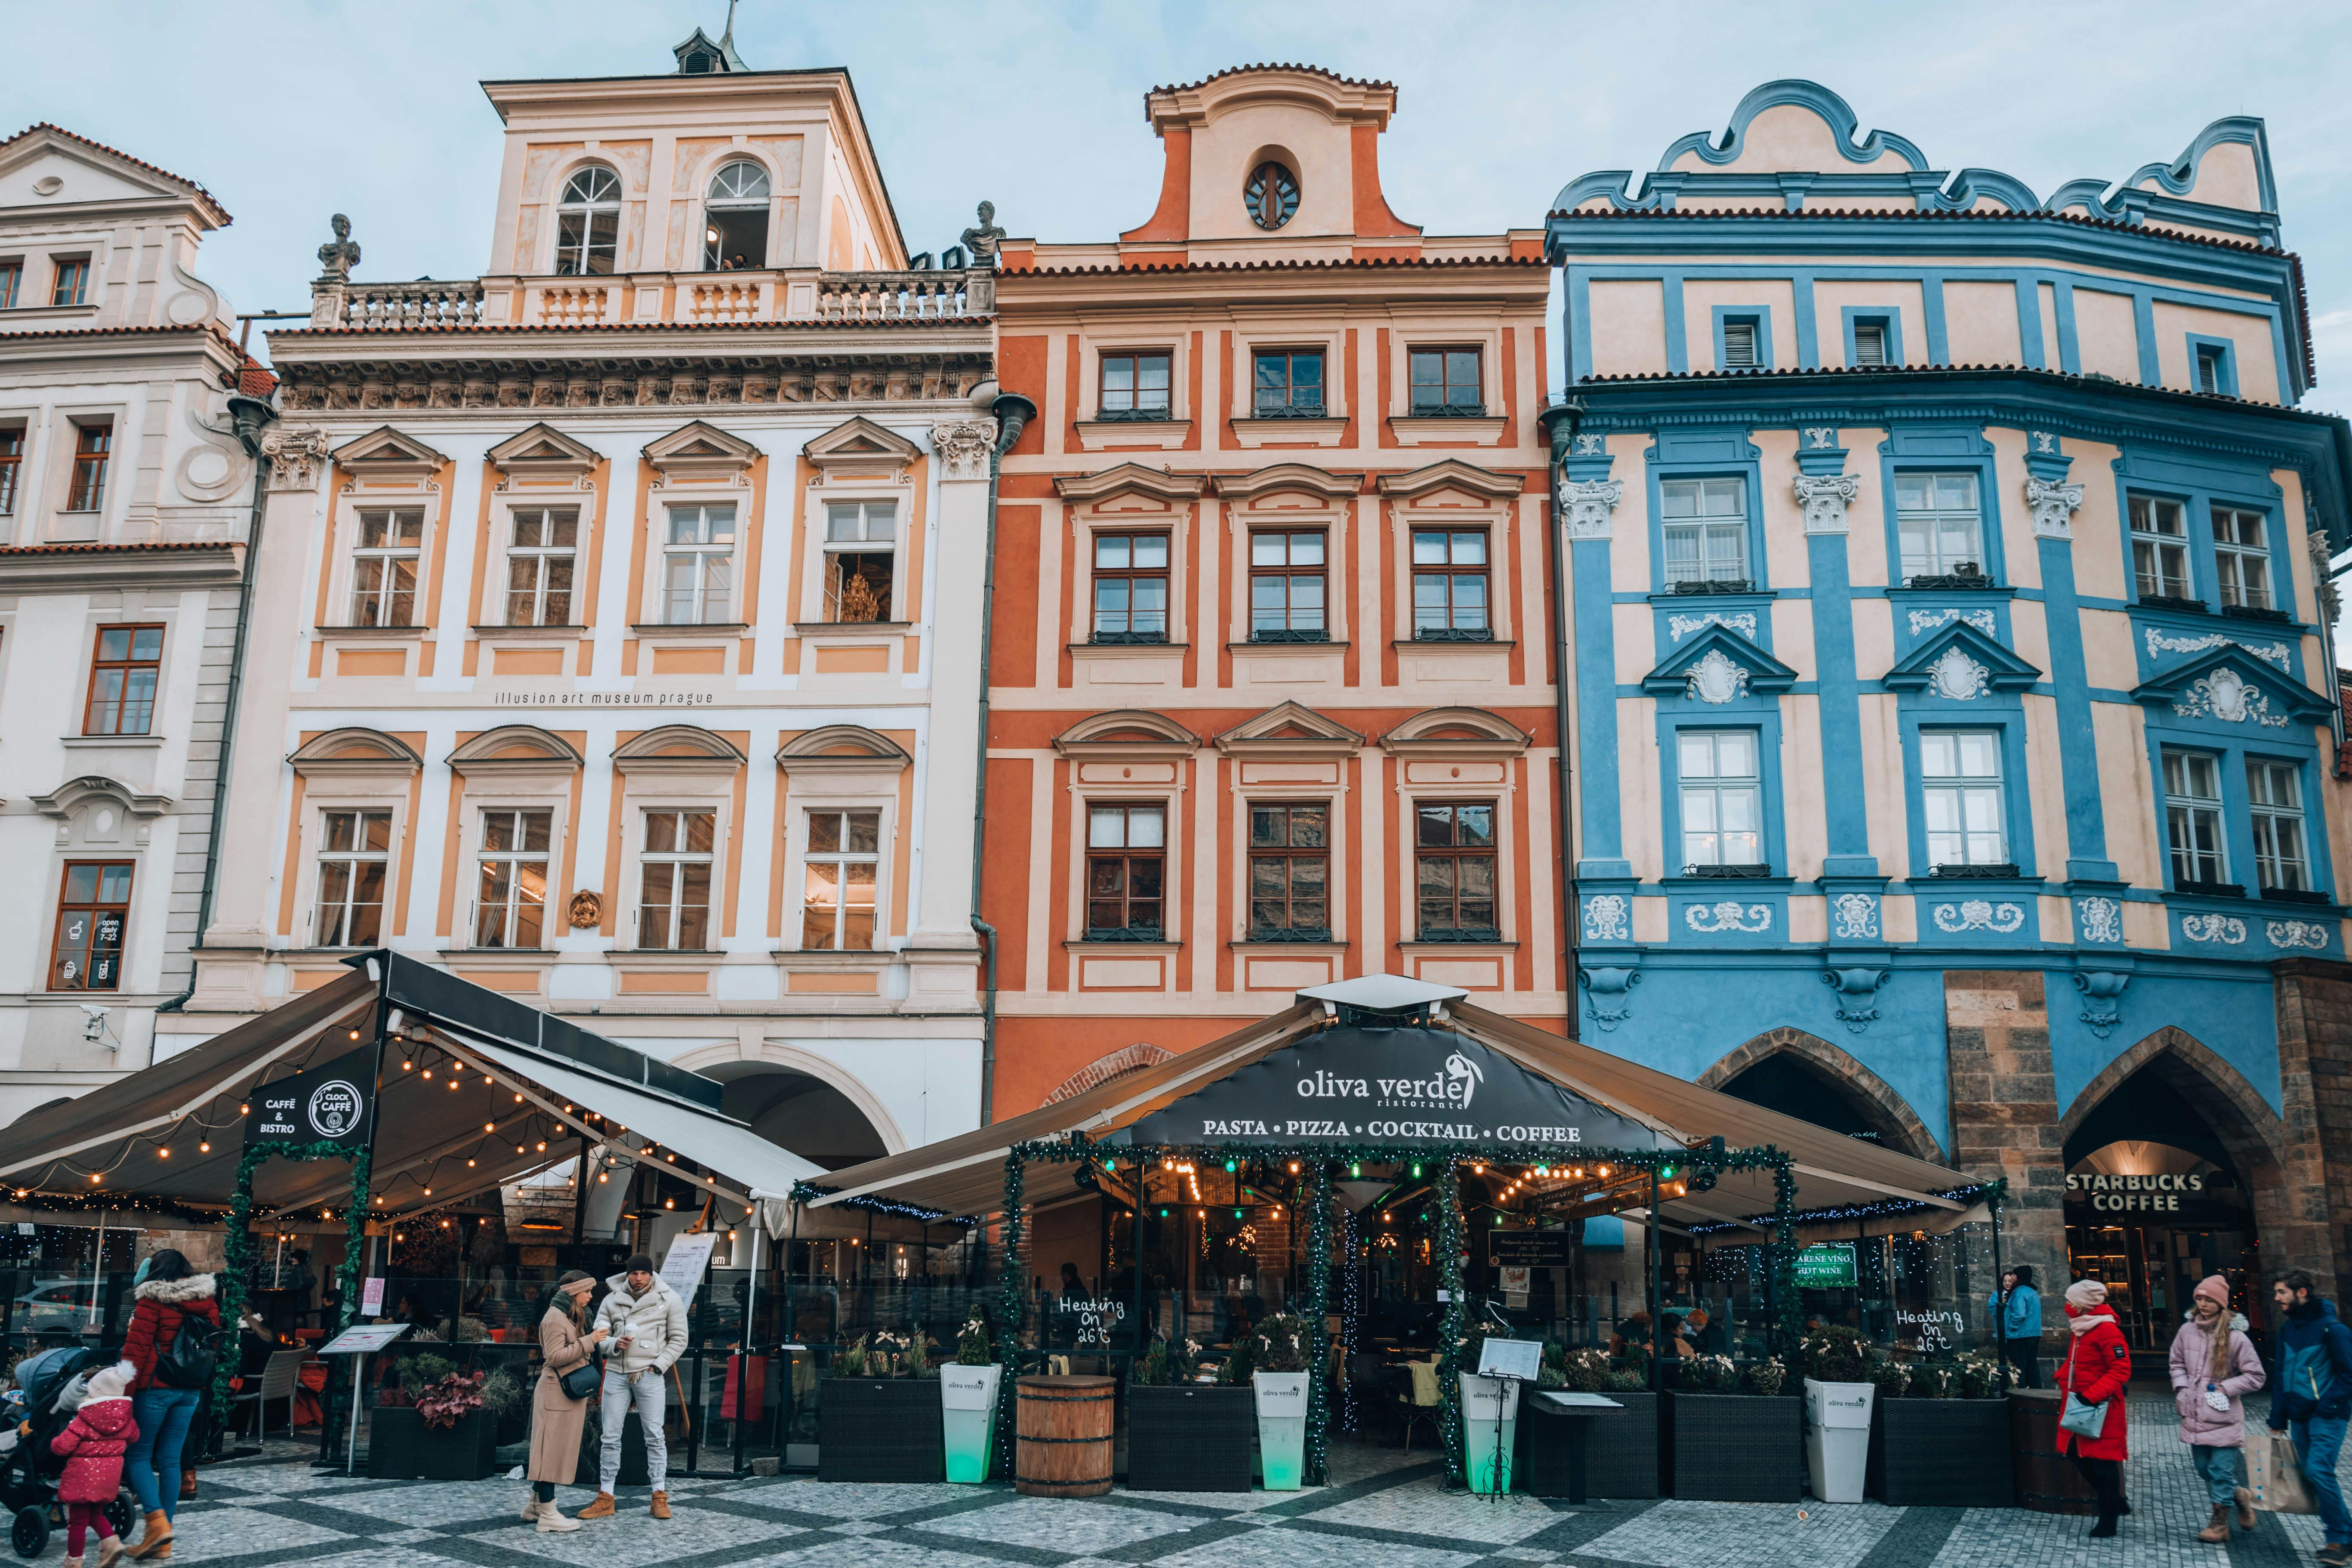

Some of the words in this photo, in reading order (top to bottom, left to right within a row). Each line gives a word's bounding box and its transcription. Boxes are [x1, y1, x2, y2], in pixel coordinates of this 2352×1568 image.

[495, 693, 555, 704] illusion
[562, 693, 583, 703] art
[592, 693, 653, 703] museum
[660, 693, 712, 705] prague
[1297, 1070, 1370, 1097] oliva
[1377, 1072, 1462, 1099] verde
[1377, 1099, 1463, 1109] ristorante
[275, 1112, 283, 1121] &
[260, 1124, 295, 1134] BISTRO
[1203, 1120, 1268, 1135] PASTA
[1286, 1121, 1350, 1136] PIZZA
[1368, 1121, 1478, 1140] COCKTAIL
[1497, 1126, 1581, 1142] COFFEE
[2065, 1174, 2202, 1191] STARBUCKS
[2093, 1195, 2179, 1211] COFFEE
[1797, 1254, 1826, 1263] AŘENÉ
[1828, 1254, 1850, 1263] VÍNO
[1060, 1297, 1125, 1319] Heating
[1081, 1312, 1100, 1326] On
[1896, 1309, 1964, 1333] Heating
[1923, 1323, 1941, 1337] On
